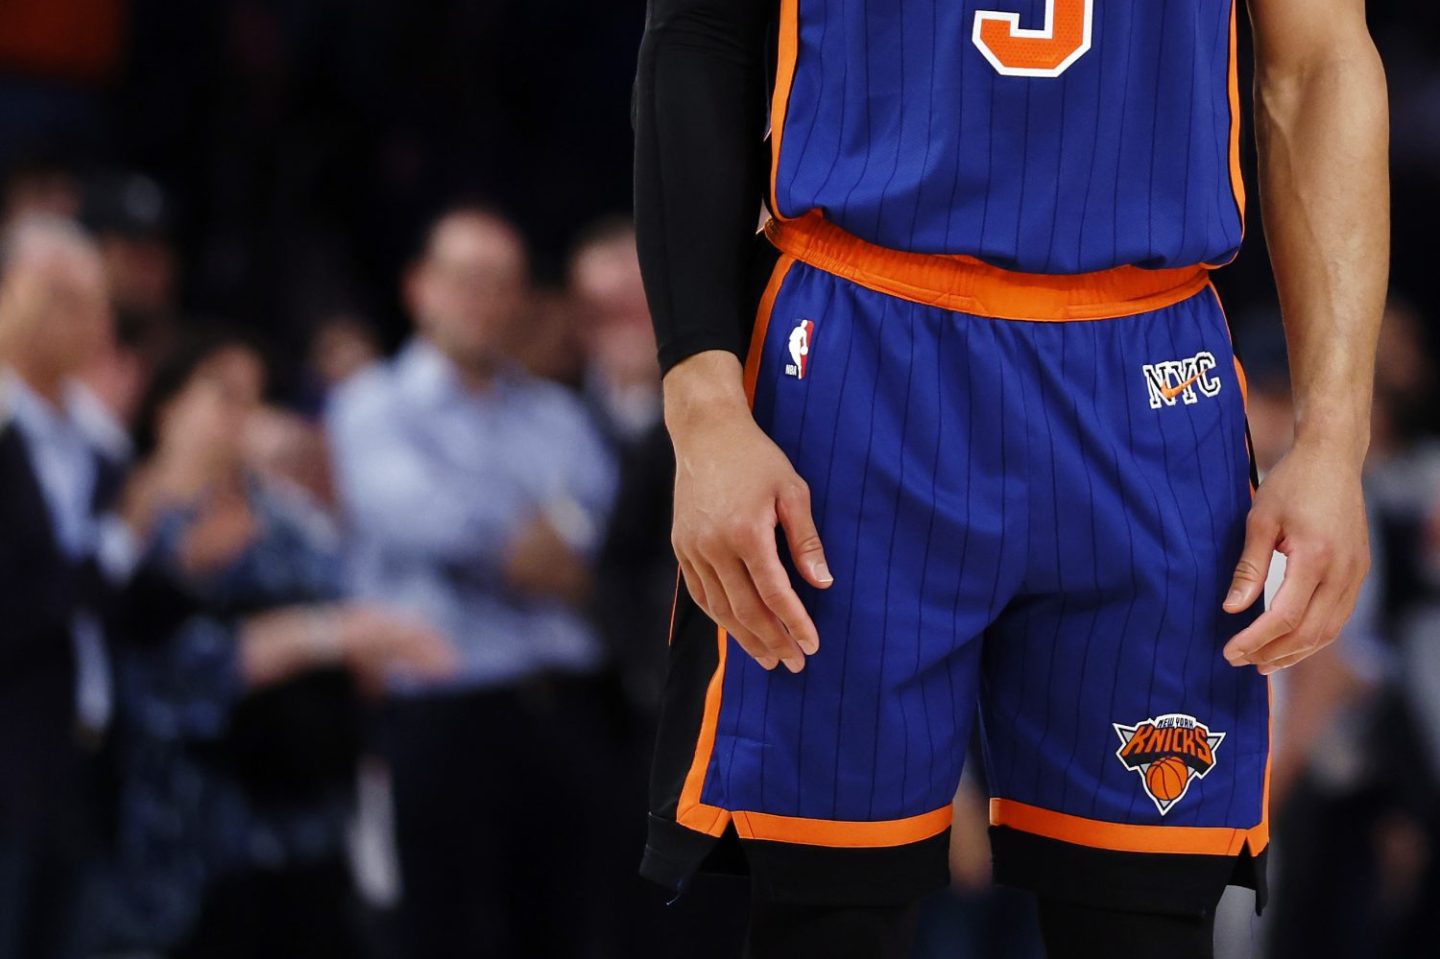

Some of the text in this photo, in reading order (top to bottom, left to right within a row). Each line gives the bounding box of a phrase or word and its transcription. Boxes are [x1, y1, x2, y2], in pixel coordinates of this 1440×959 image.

[785, 364, 797, 376] NBA
[1142, 352, 1221, 409] NYC
[1120, 723, 1214, 766] KNICKS
